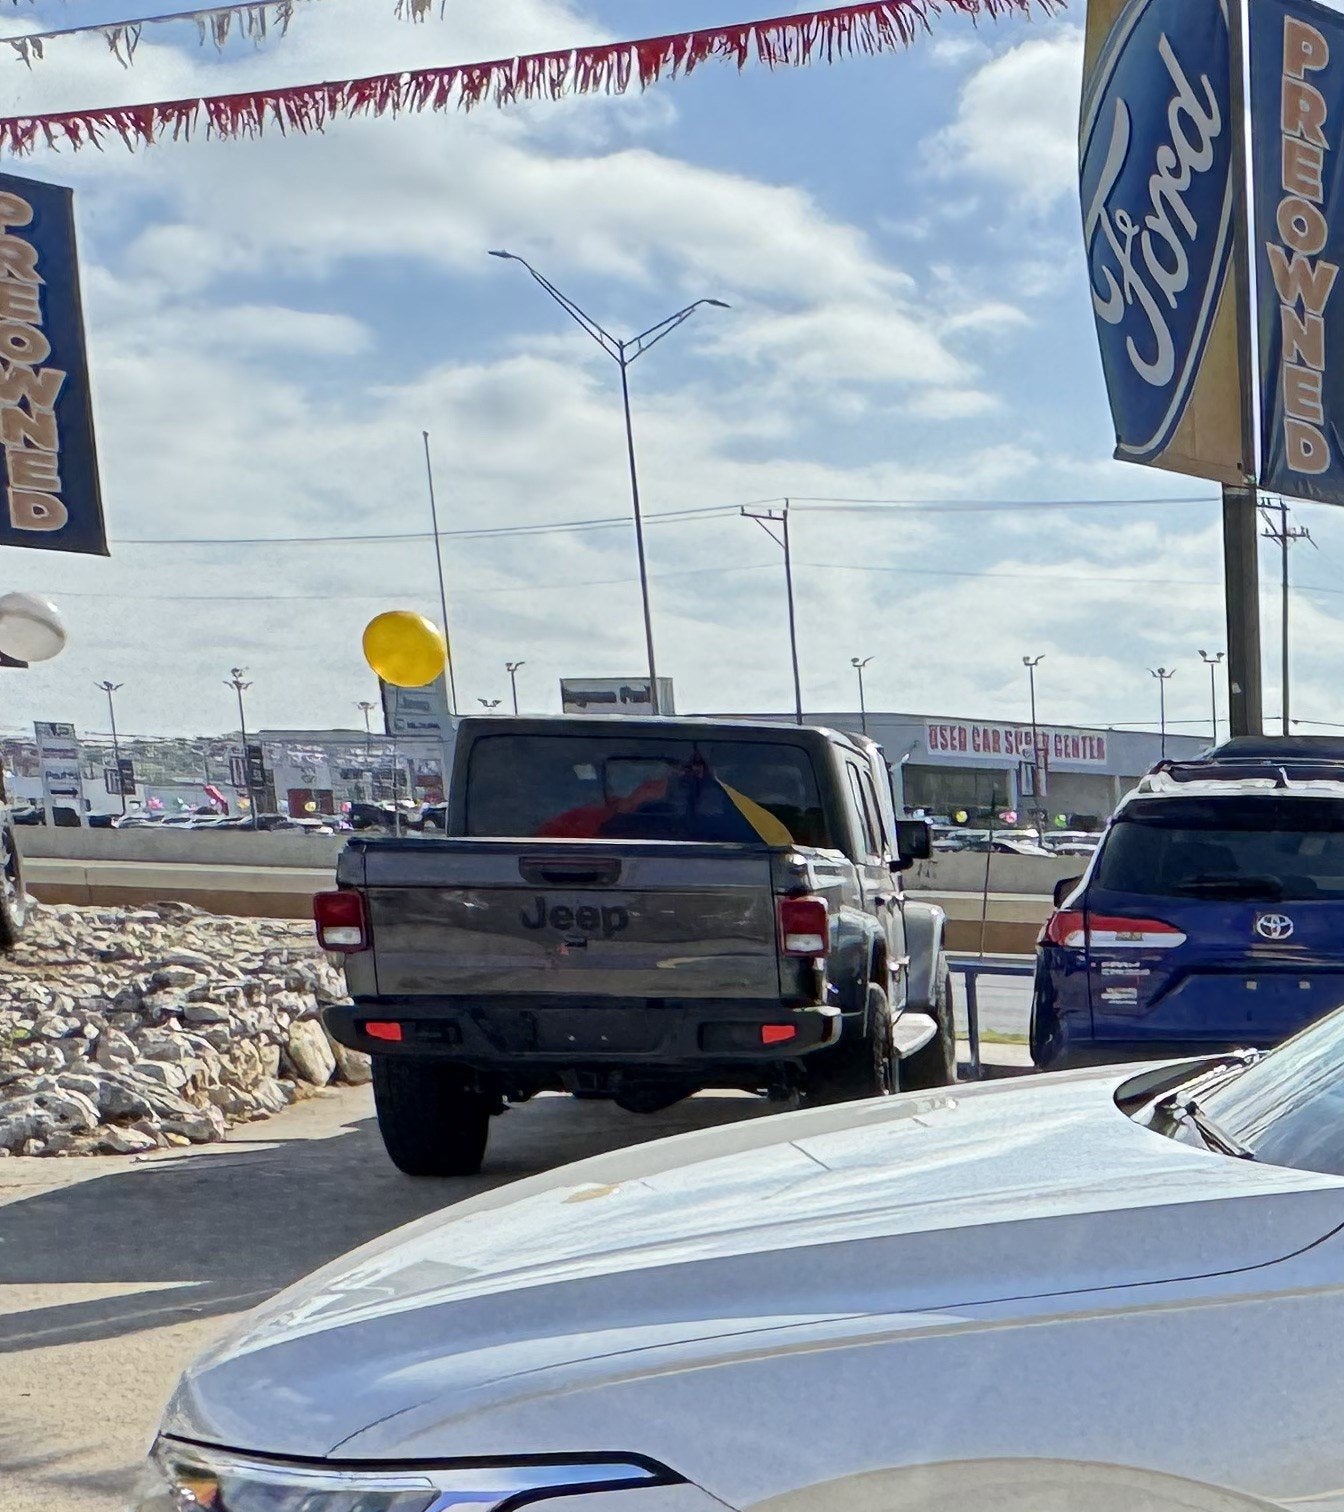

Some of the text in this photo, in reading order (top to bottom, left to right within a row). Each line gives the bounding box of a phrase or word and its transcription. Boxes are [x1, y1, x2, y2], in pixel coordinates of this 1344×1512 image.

[1085, 32, 1222, 388] Ford
[1266, 14, 1340, 475] PREOWNED
[928, 724, 1106, 760] USED CAR SUPR CENTER
[520, 895, 629, 938] Jeep
